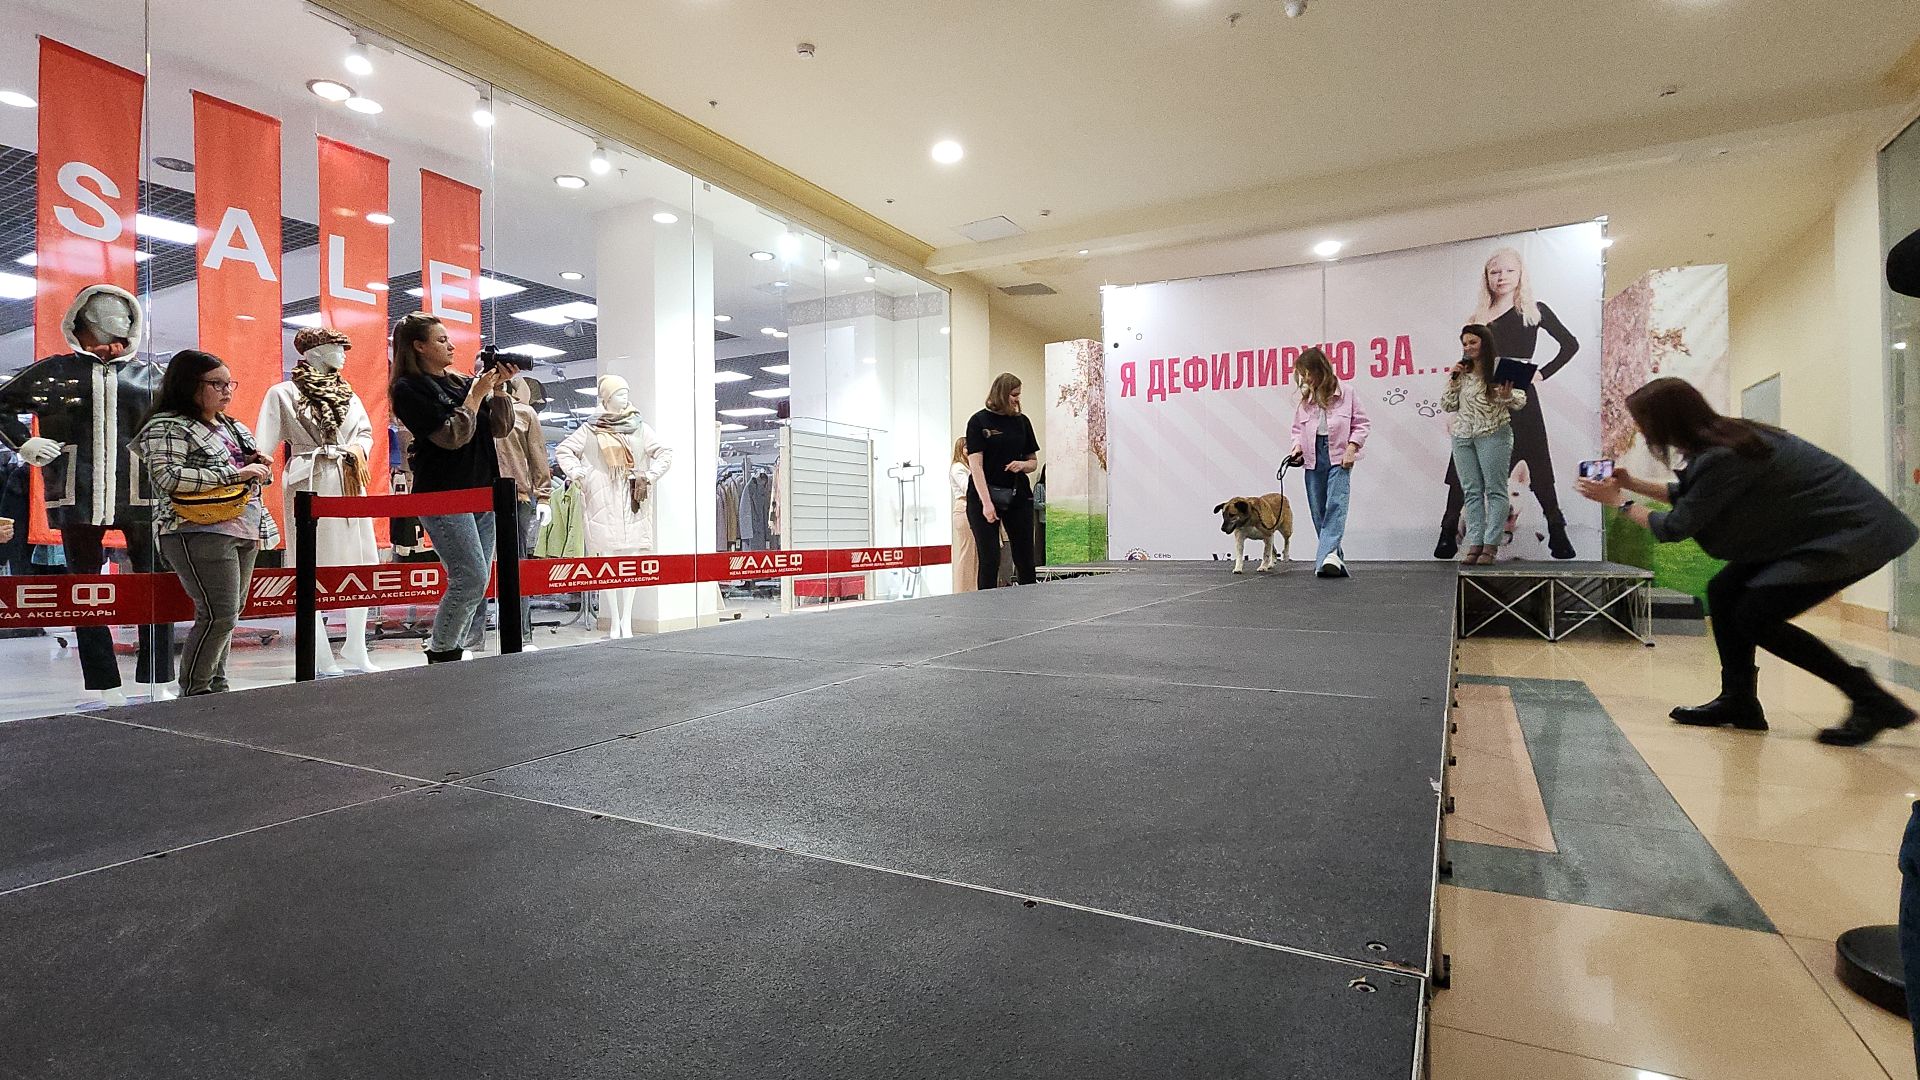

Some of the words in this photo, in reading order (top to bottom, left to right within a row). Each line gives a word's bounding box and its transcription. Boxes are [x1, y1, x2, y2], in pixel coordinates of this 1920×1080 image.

[53, 161, 473, 324] SALE
[1120, 361, 1136, 398] Я
[1147, 341, 1355, 402] ДЕФИЛИРЮ
[744, 554, 803, 570] АЛЕФ
[862, 550, 903, 563] АЛЕФ
[571, 560, 660, 580] АЛЕФ
[338, 593, 377, 602] ОДЕЖДА
[381, 589, 439, 598] АКСЕССУАРЫ
[27, 610, 116, 618] АКСЕССУАРЫ
